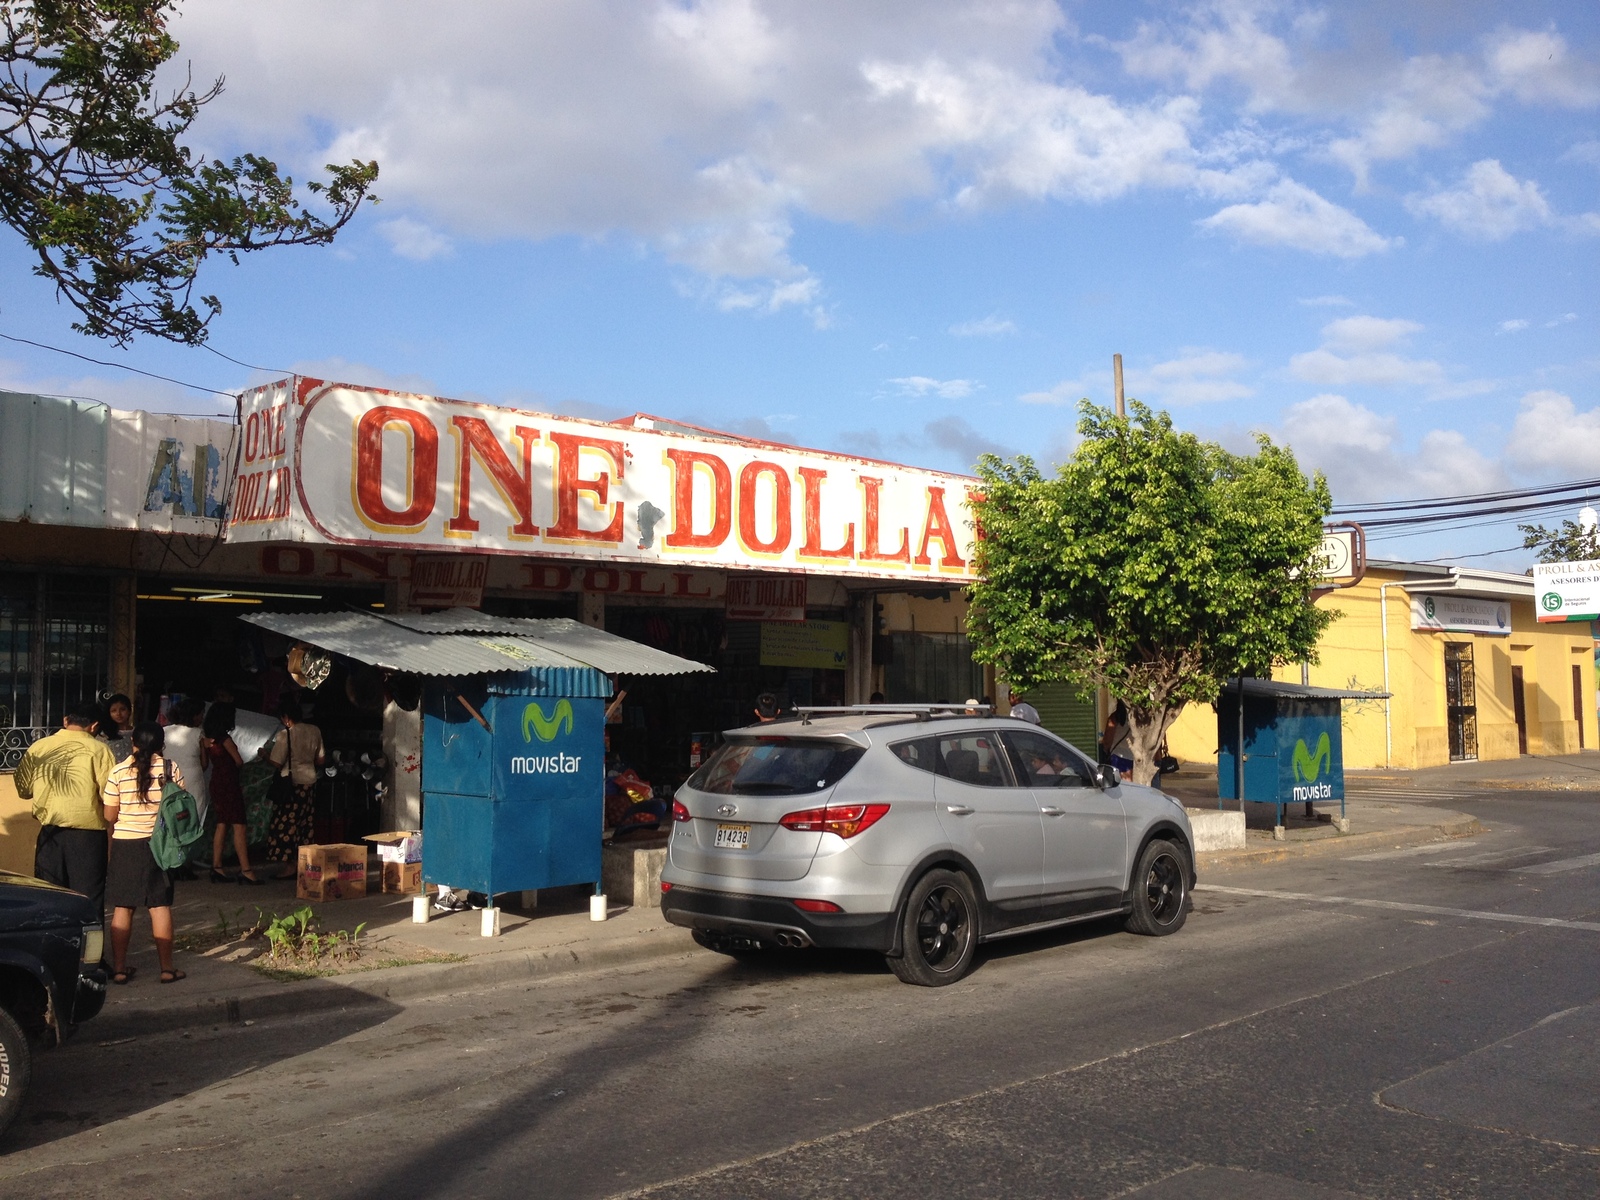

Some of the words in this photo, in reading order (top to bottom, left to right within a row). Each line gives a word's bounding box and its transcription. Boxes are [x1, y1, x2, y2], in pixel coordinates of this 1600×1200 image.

[244, 402, 288, 466] ONE
[353, 405, 626, 548] ONE
[230, 466, 291, 527] DOLLAR
[412, 561, 435, 587] ONE
[434, 561, 485, 589] DOLLAR
[1538, 564, 1573, 575] PROLL
[1576, 563, 1585, 573] &
[1550, 576, 1592, 585] ASESORES
[728, 579, 751, 605] ONE
[755, 579, 804, 607] DOLLAR
[808, 622, 831, 631] STORE
[511, 751, 581, 775] movistar
[1293, 782, 1332, 801] movistar
[717, 829, 748, 844] 814238
